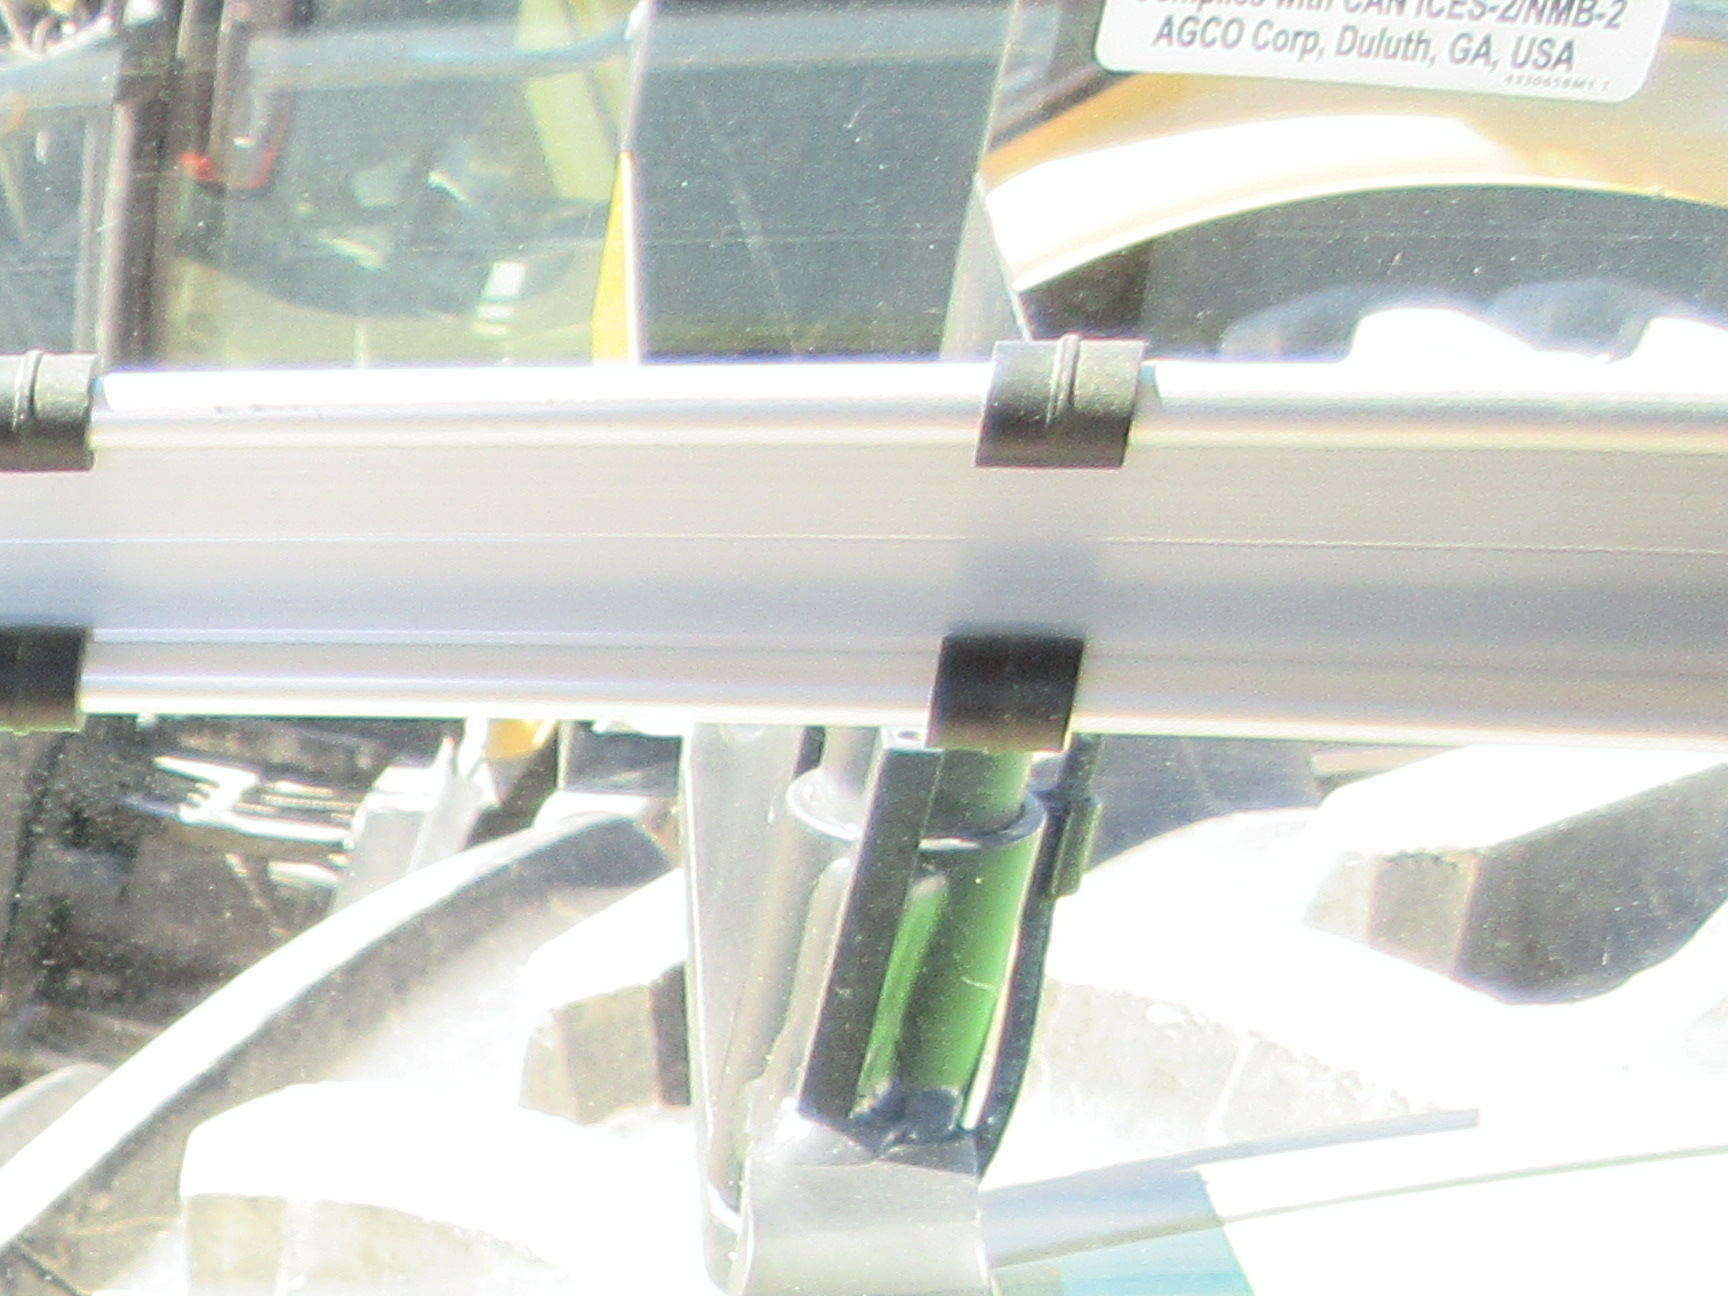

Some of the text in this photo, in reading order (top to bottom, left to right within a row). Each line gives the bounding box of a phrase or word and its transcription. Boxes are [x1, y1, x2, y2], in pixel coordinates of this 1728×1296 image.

[1151, 14, 1577, 73] AGCO Corp, Duluth, GA, USA
